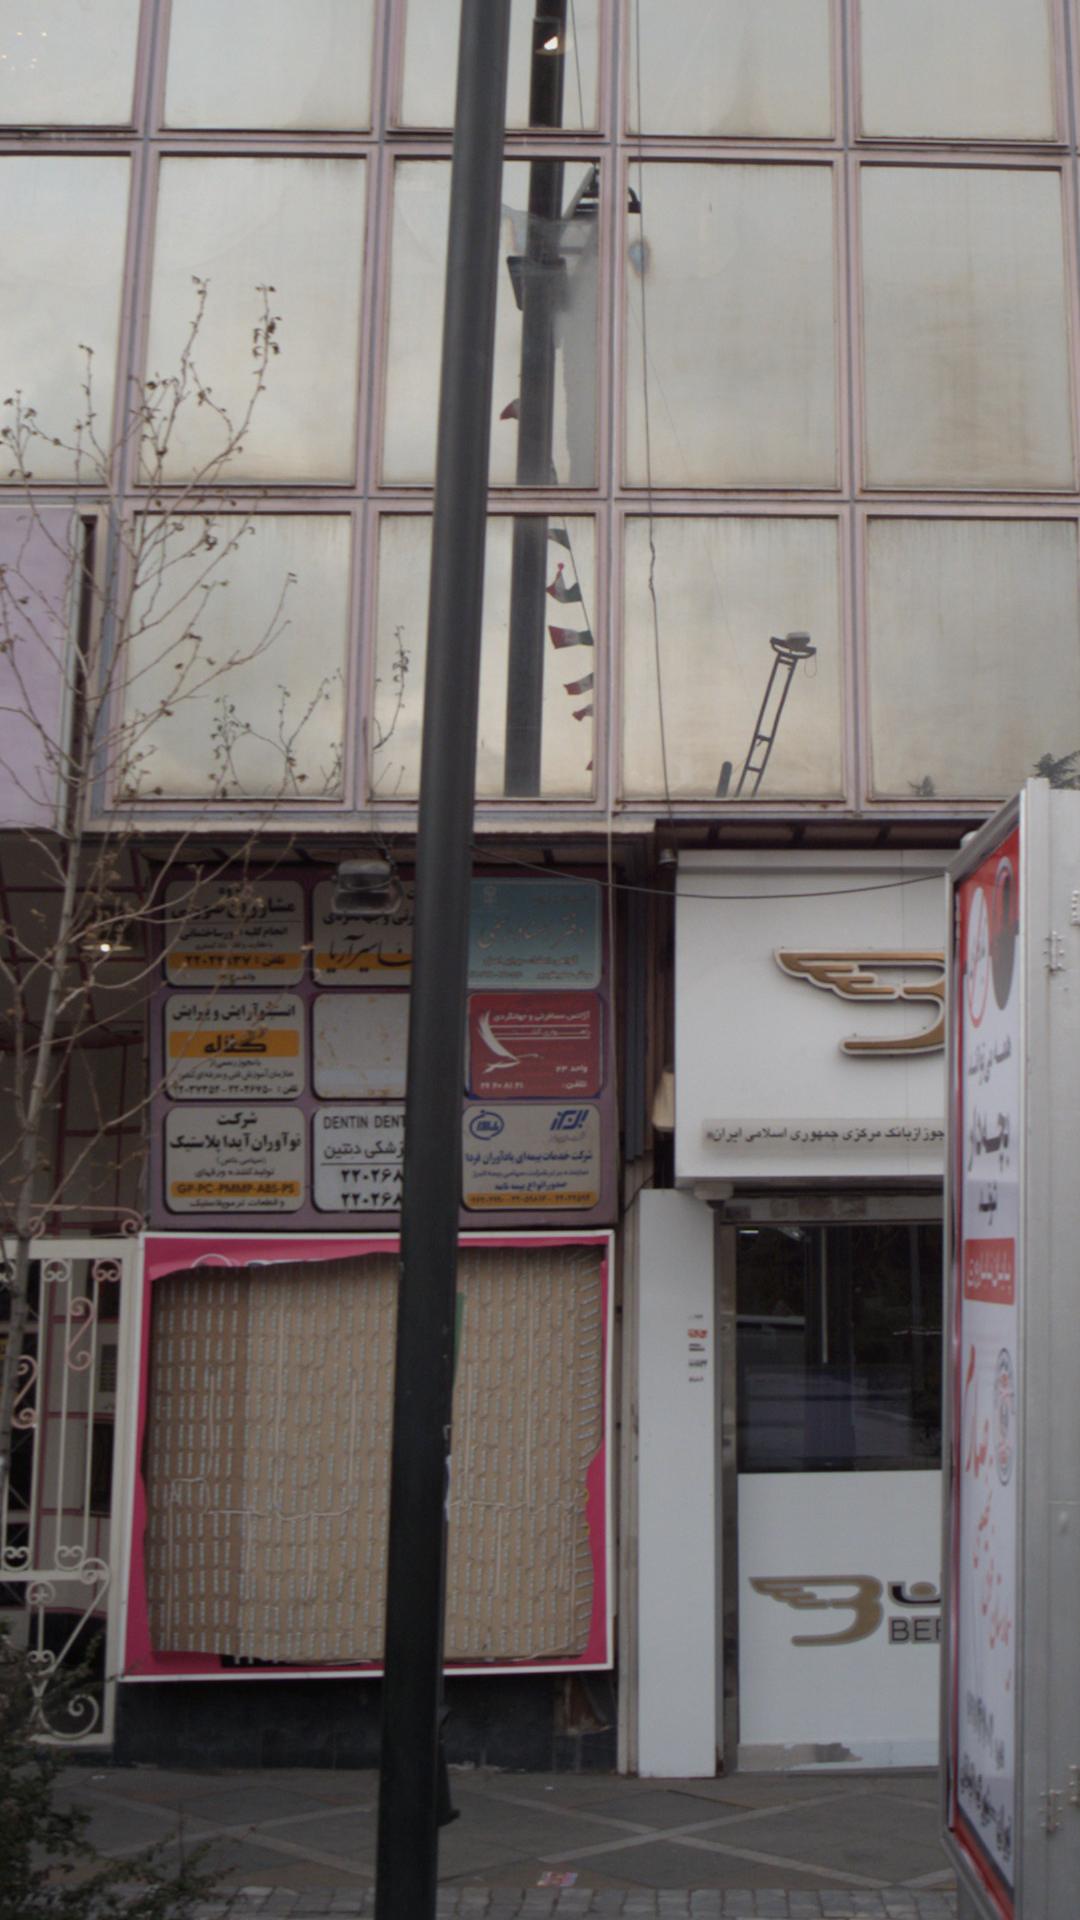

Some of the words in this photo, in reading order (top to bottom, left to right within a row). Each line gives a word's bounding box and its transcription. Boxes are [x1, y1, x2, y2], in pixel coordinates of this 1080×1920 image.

[217, 1111, 258, 1129] شرکت
[323, 1115, 369, 1130] DENTIN
[374, 1115, 406, 1129] DENT
[744, 1127, 787, 1143] اسلامی
[790, 1129, 839, 1143] جمهوری
[842, 1128, 882, 1143] مرکزی
[884, 1126, 912, 1142] بانک
[923, 1127, 945, 1142] جوز
[169, 1133, 221, 1153] پلاستیک
[251, 1132, 302, 1153] نوآوران
[365, 1140, 405, 1159] زشکی
[340, 1168, 405, 1184] ۲۲۰۲۶۸
[340, 1192, 405, 1207] ۲۲۰۲۶۸
